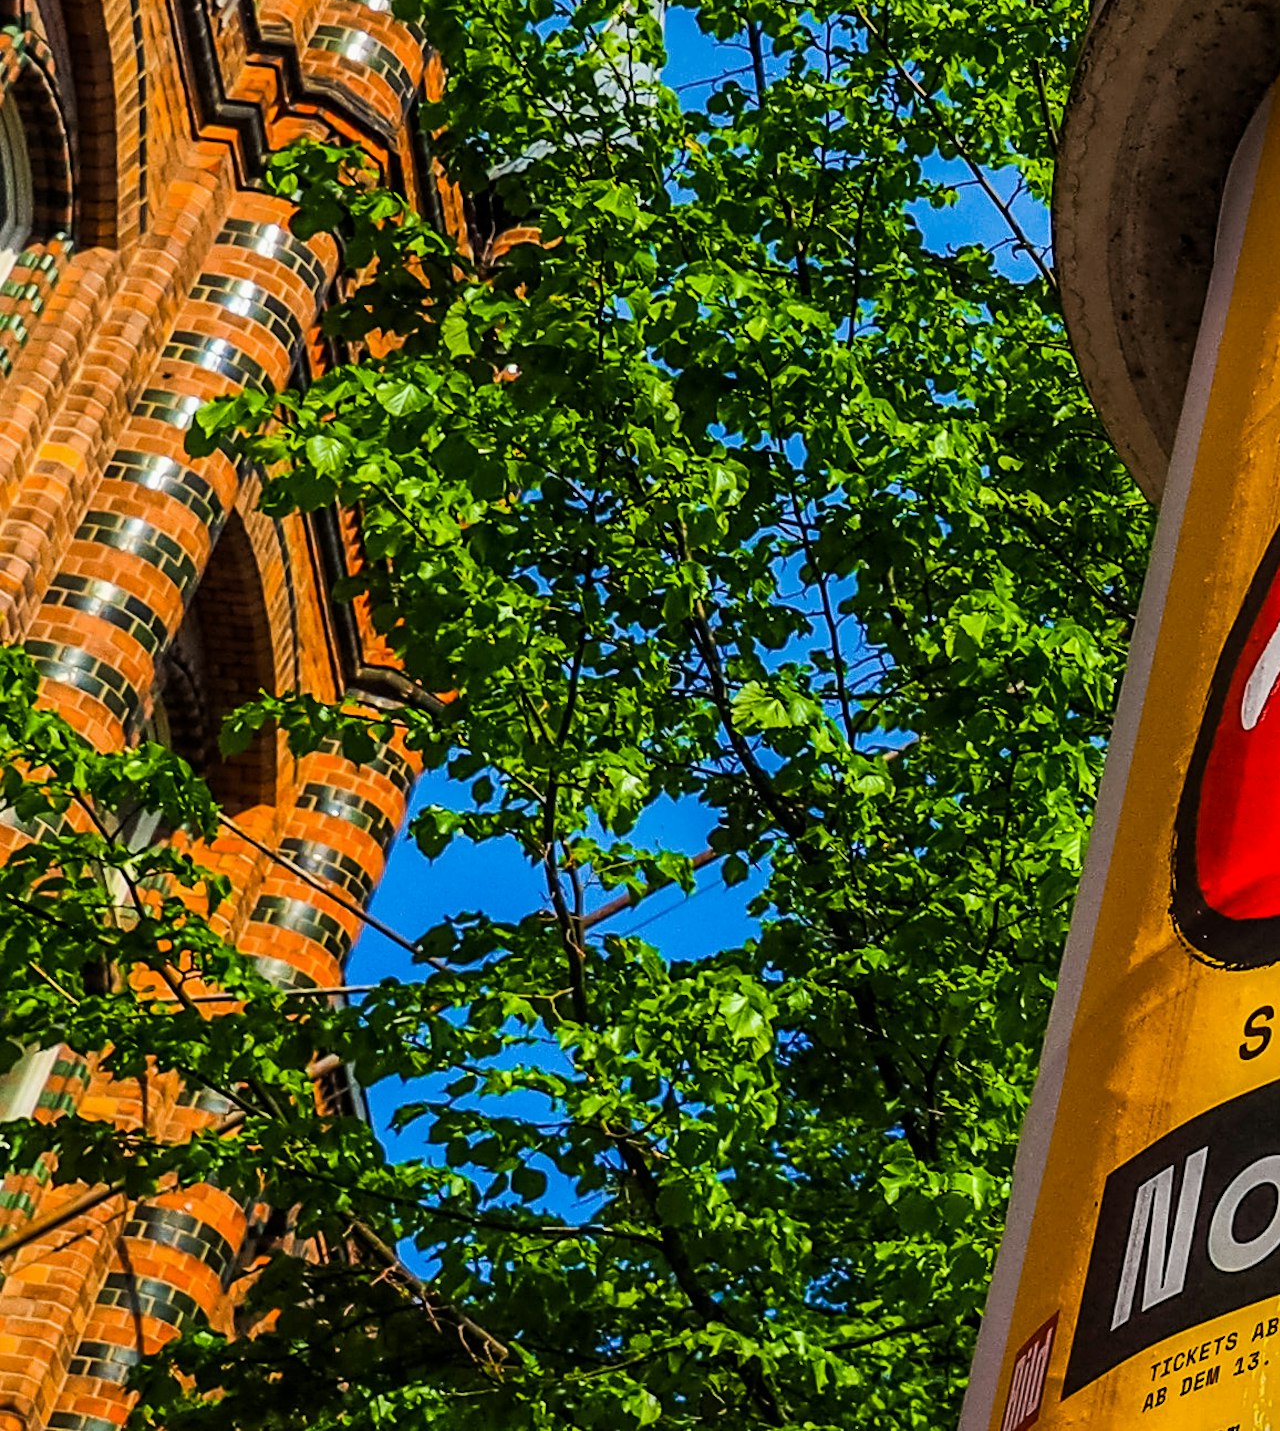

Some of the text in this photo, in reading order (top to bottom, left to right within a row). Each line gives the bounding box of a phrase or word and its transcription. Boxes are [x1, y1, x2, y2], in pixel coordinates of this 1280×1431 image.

[1151, 1332, 1238, 1382] TICKETS
[1251, 1318, 1279, 1342] AB
[1141, 1387, 1168, 1413] AB
[1179, 1365, 1221, 1397] DEM
[1232, 1351, 1270, 1377] 13.
